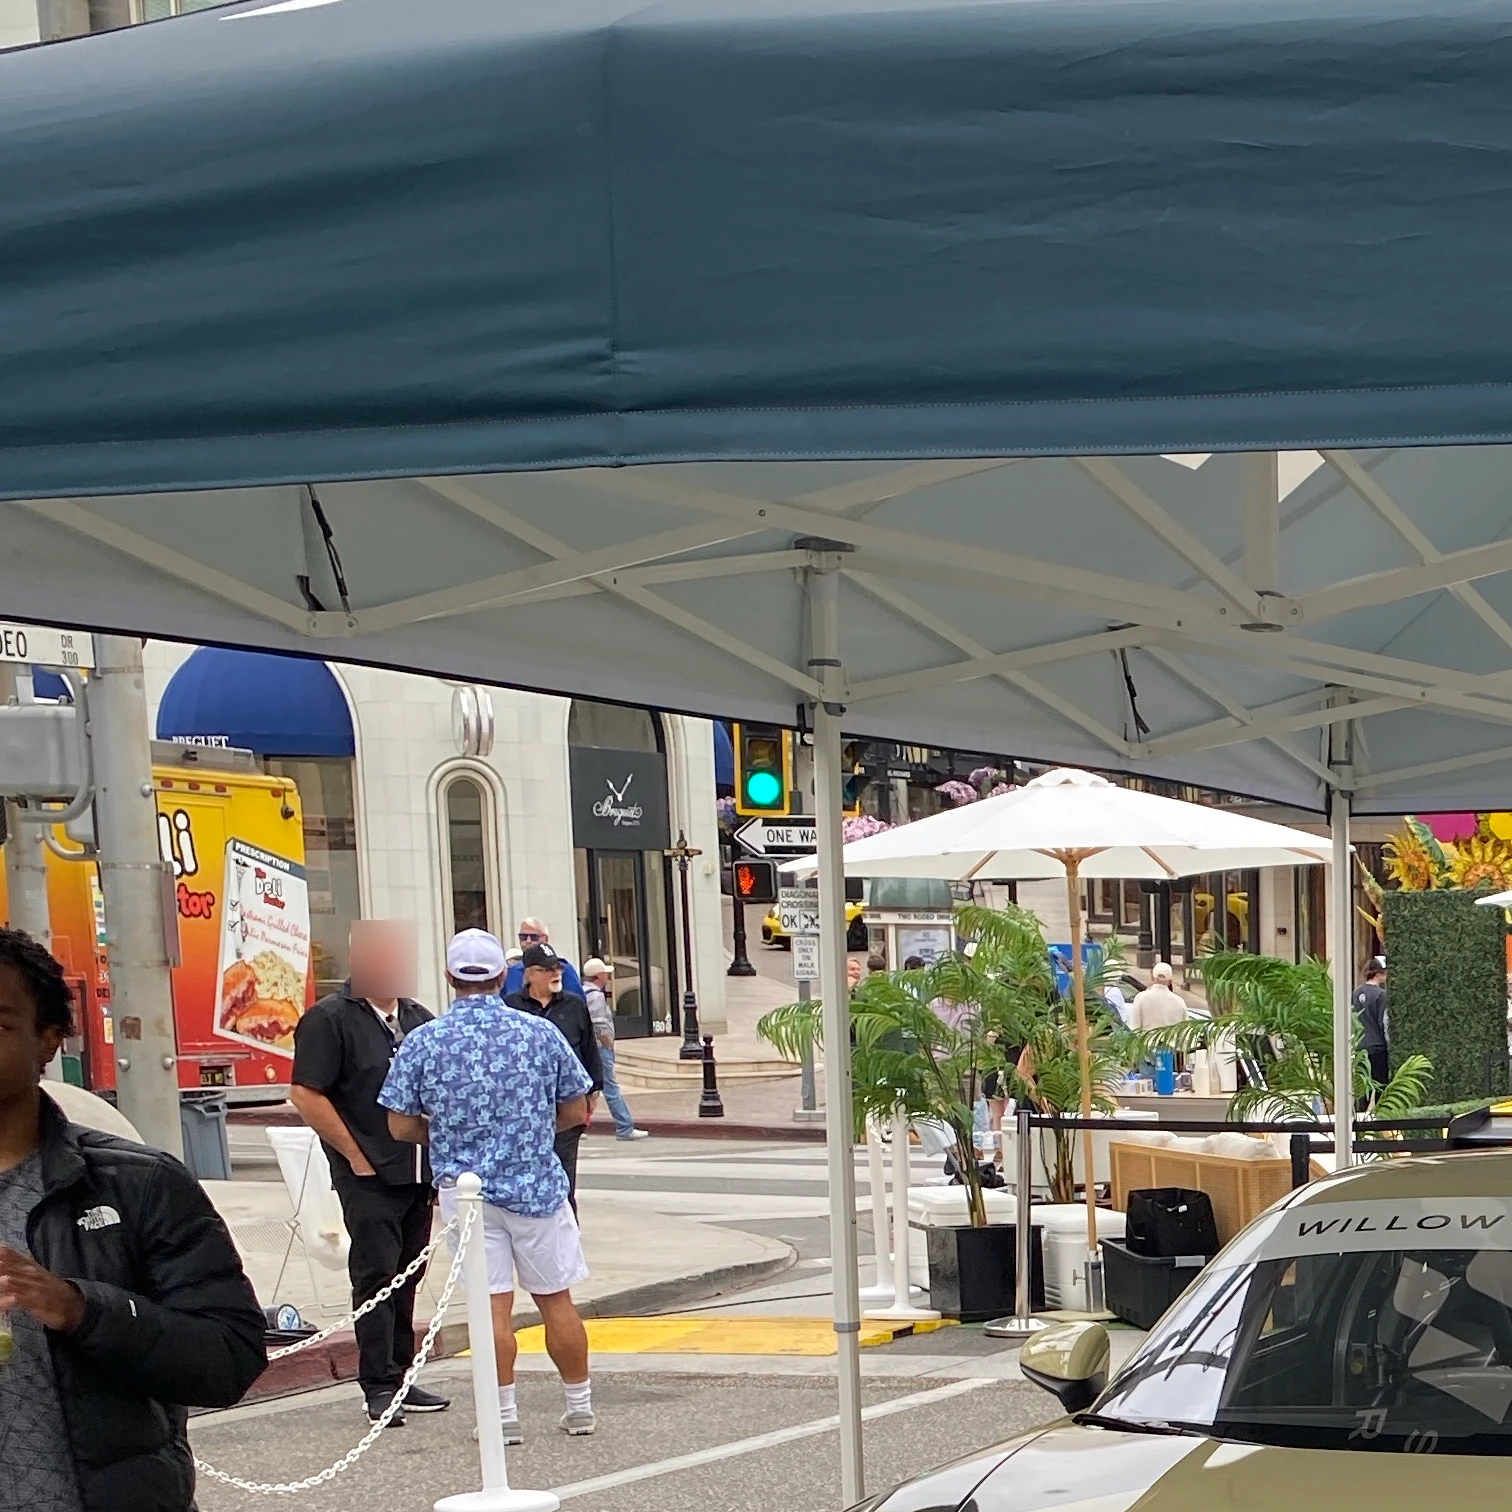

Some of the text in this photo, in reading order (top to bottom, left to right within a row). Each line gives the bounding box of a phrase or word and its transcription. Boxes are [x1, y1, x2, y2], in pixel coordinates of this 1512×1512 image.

[0, 630, 27, 657] EO
[60, 634, 74, 650] DR
[61, 651, 79, 666] 300
[157, 808, 198, 877] li
[766, 829, 818, 844] ONE WA
[235, 841, 290, 871] PRESCRIPTION
[255, 876, 283, 898] Deli
[781, 890, 818, 899] DIAGONA
[176, 882, 215, 919] tor
[781, 900, 818, 909] CROSSIN
[781, 913, 798, 929] OK
[1298, 1213, 1506, 1238] WILLOW
